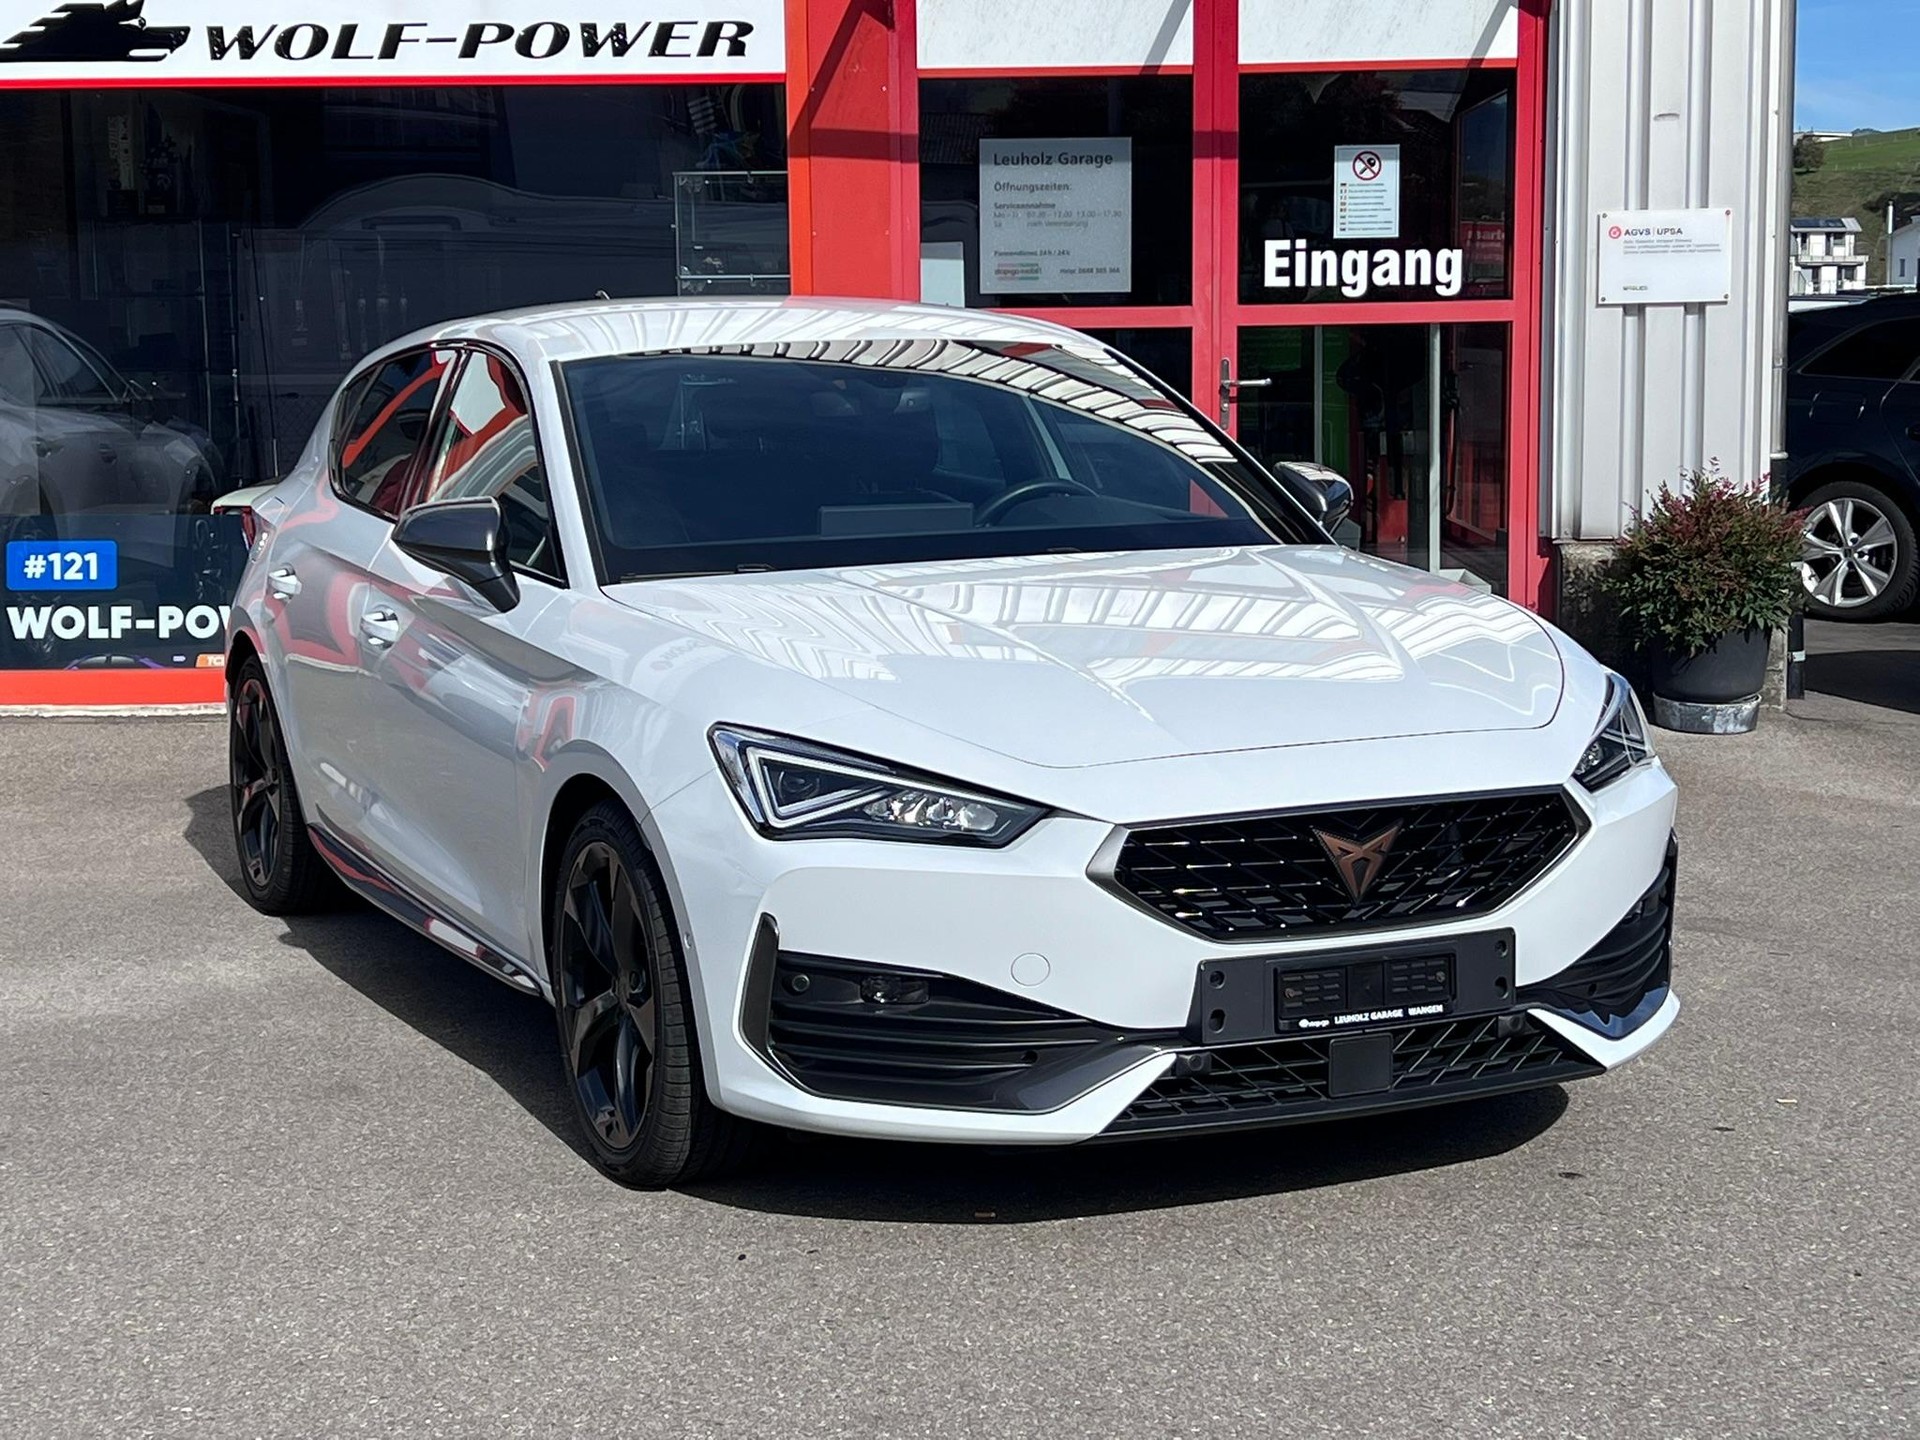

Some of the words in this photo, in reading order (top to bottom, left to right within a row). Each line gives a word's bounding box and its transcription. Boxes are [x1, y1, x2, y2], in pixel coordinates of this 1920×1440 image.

[205, 20, 755, 61] WOLF-POWER
[993, 152, 1054, 166] Leuholz
[1058, 152, 1113, 168] Garage
[1624, 228, 1651, 236] AGVS
[1656, 227, 1684, 236] UPSA
[1264, 239, 1463, 298] Eingang
[24, 552, 98, 580] #121
[6, 605, 231, 640] WOLF-PO
[1334, 1012, 1369, 1025] LEUHOLZ
[1370, 1009, 1403, 1020] GARAGE
[1408, 1004, 1444, 1016] WANGEN
